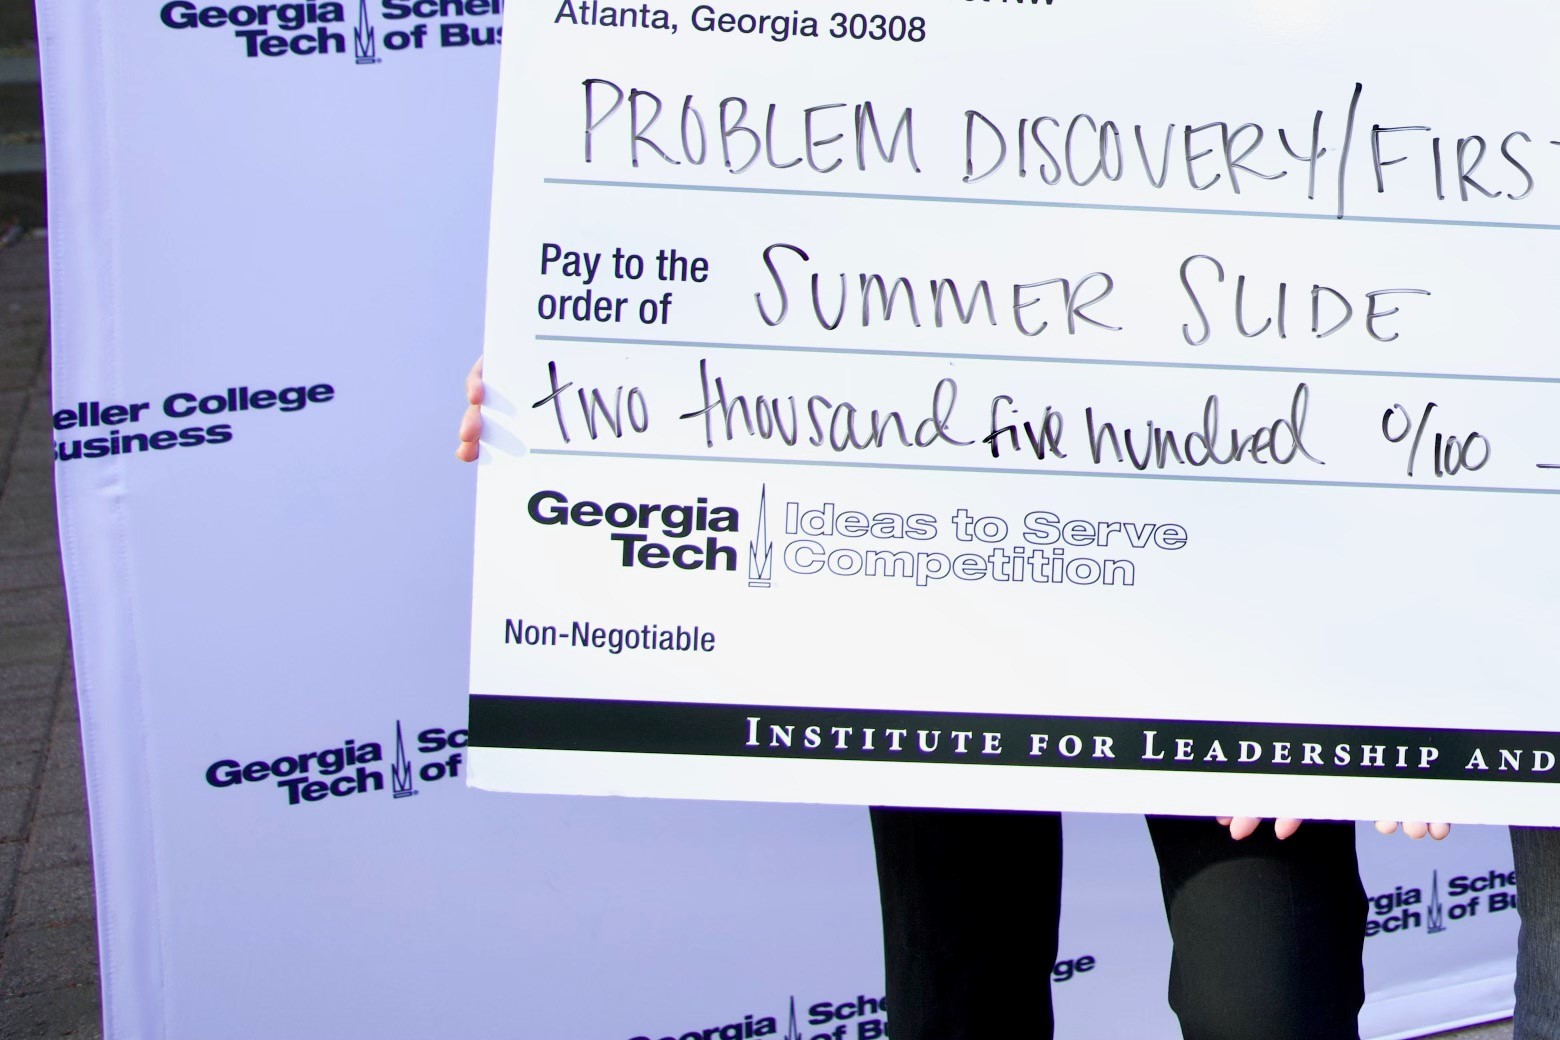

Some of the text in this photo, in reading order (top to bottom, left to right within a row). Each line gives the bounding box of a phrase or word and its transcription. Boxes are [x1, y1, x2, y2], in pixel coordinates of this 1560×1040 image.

[383, 24, 428, 51] of
[554, 0, 927, 45] Atlanta, Georgia 30308
[234, 27, 346, 59] Tech
[583, 78, 920, 175] PROBLEM
[540, 243, 709, 283] Pay to the
[538, 292, 672, 324] order of
[754, 243, 1432, 346] SUMMER SLIDE
[53, 383, 335, 430] eller College
[532, 360, 650, 445] two
[680, 359, 976, 448] thousand
[982, 394, 1070, 460] five
[1084, 383, 1325, 471] hundred
[53, 423, 233, 462] usiness
[527, 490, 740, 536] Georgia
[784, 502, 1188, 550] Ideas to Serve
[610, 534, 738, 571] Tech
[783, 541, 1136, 587] Competition
[504, 618, 717, 654] Non-Negotiable
[205, 740, 382, 788] Georgia
[744, 717, 1003, 755] INSTITUTE
[1029, 733, 1117, 759] FOR
[1141, 730, 1440, 772] LEADERSHIP
[1466, 748, 1558, 773] AND
[419, 753, 462, 781] of
[278, 770, 383, 805] Tech
[1366, 909, 1421, 937] ech
[1448, 896, 1479, 920] of
